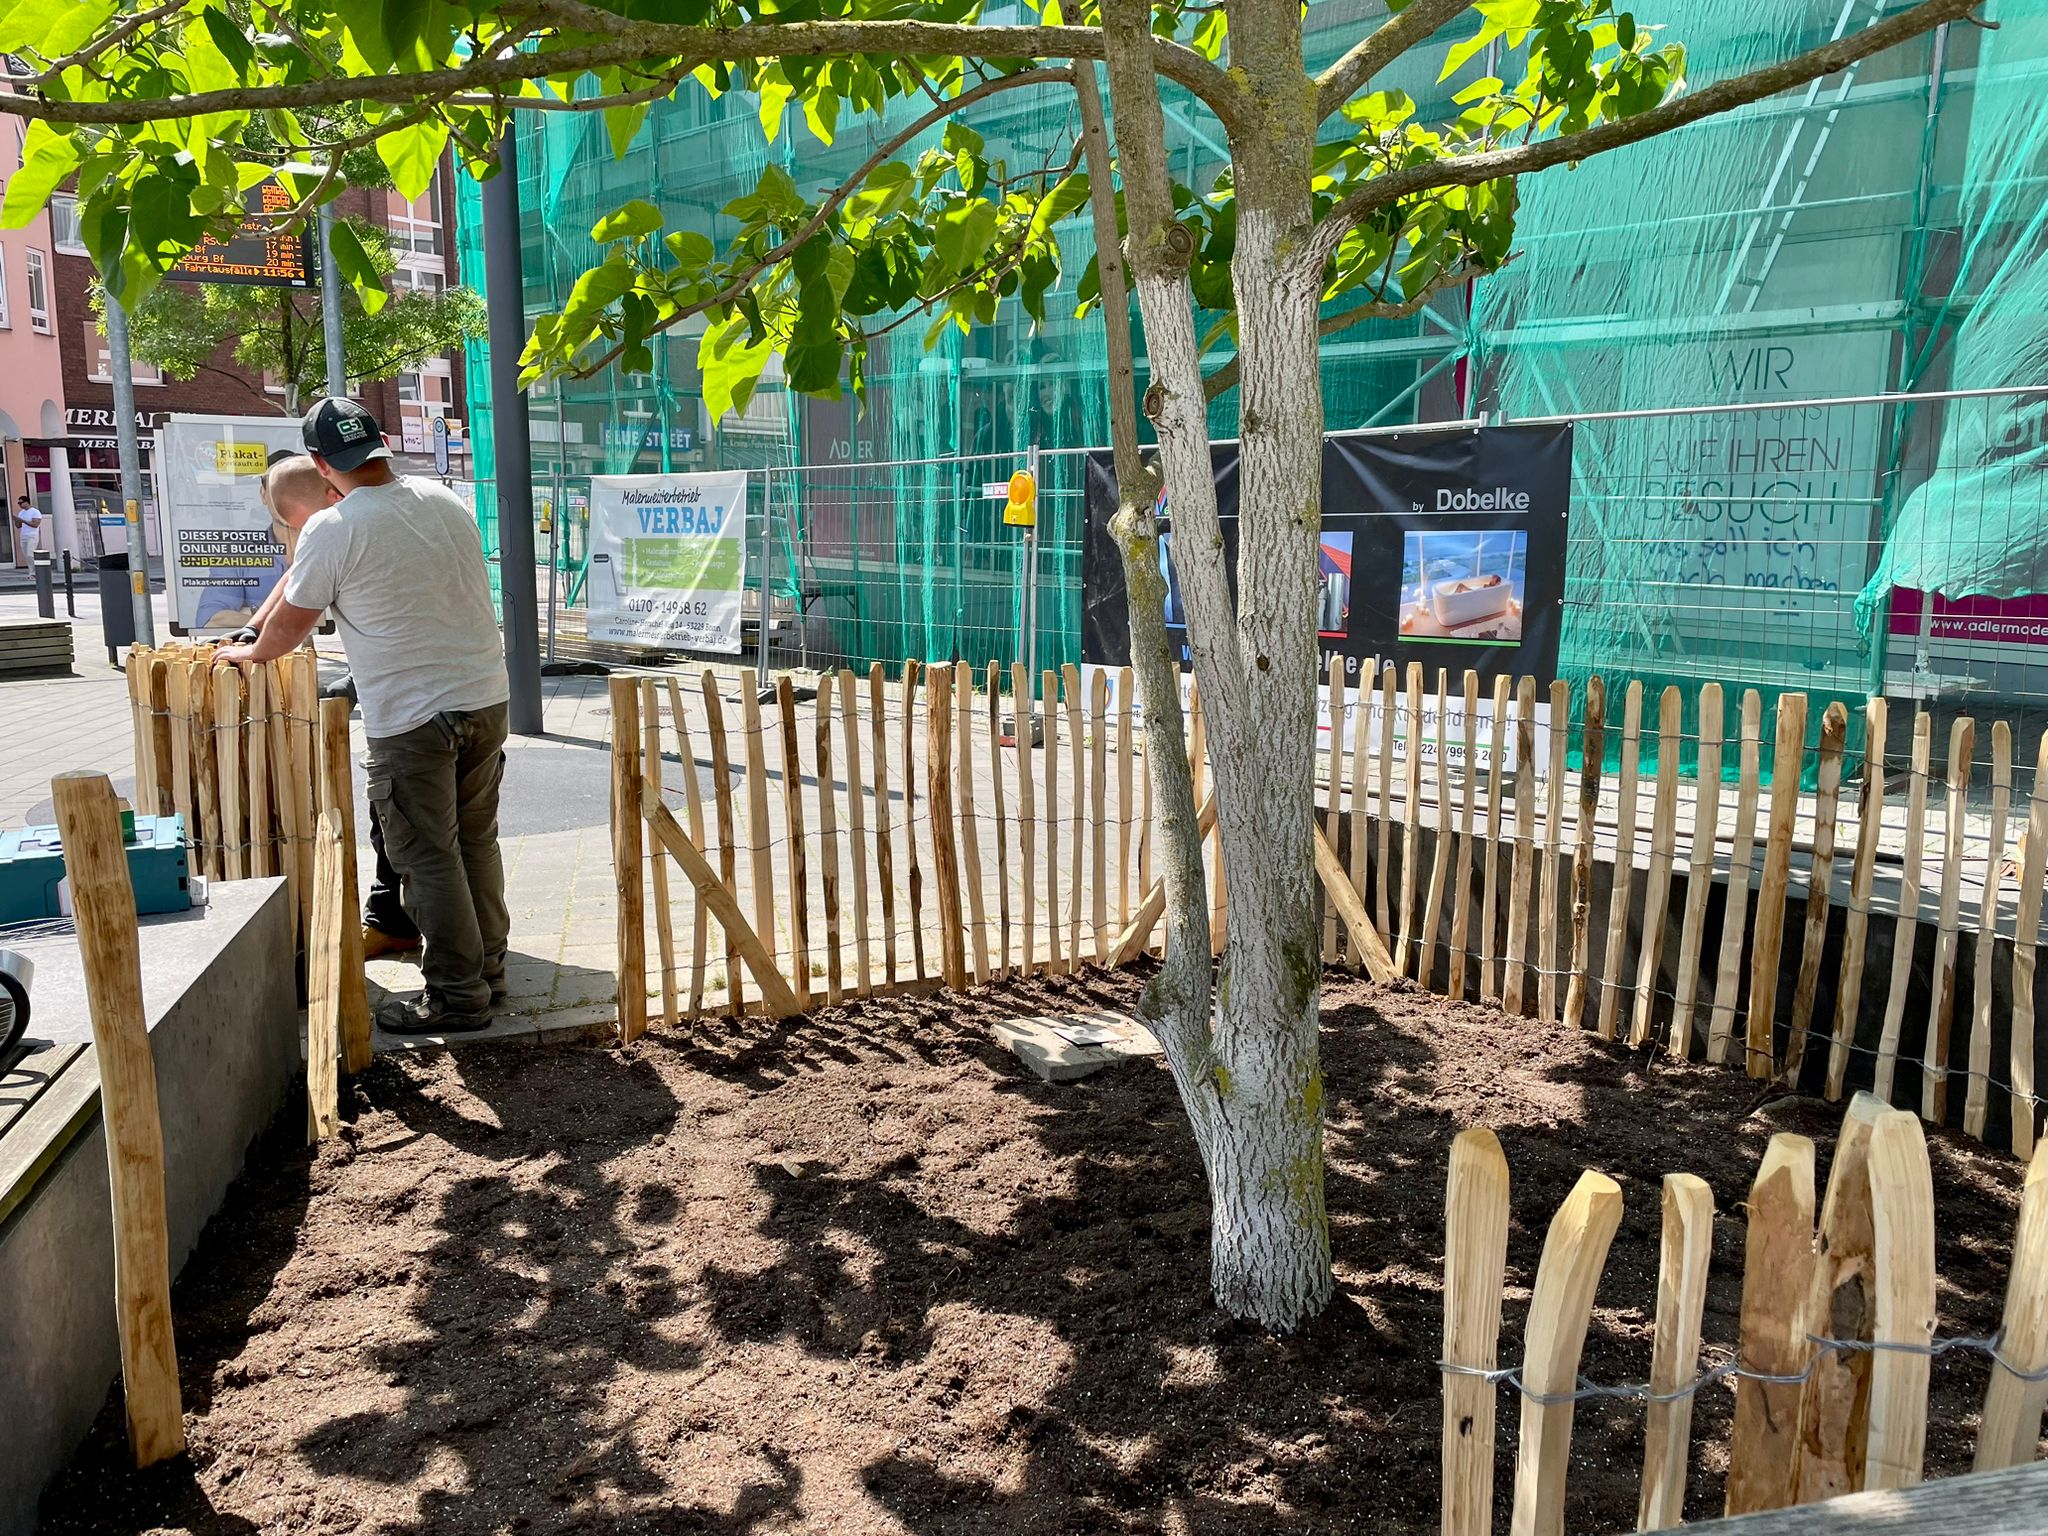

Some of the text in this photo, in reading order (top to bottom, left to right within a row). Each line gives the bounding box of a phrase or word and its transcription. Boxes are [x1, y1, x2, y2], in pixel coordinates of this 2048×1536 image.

[266, 241, 277, 249] 17
[213, 254, 224, 263] Bf
[266, 258, 279, 266] 20
[266, 250, 278, 258] 19
[263, 268, 295, 278] 11:56
[1707, 346, 1795, 391] WIR
[829, 437, 873, 459] ADER
[1727, 437, 1841, 473] IHREN
[1412, 487, 1530, 512] by Dobelke
[637, 506, 724, 534] VERBAJ
[180, 532, 267, 541] DIESES POSTER
[181, 544, 286, 554] ONLINE BUCHEN?
[628, 599, 653, 612] 0170
[694, 601, 707, 615] 62
